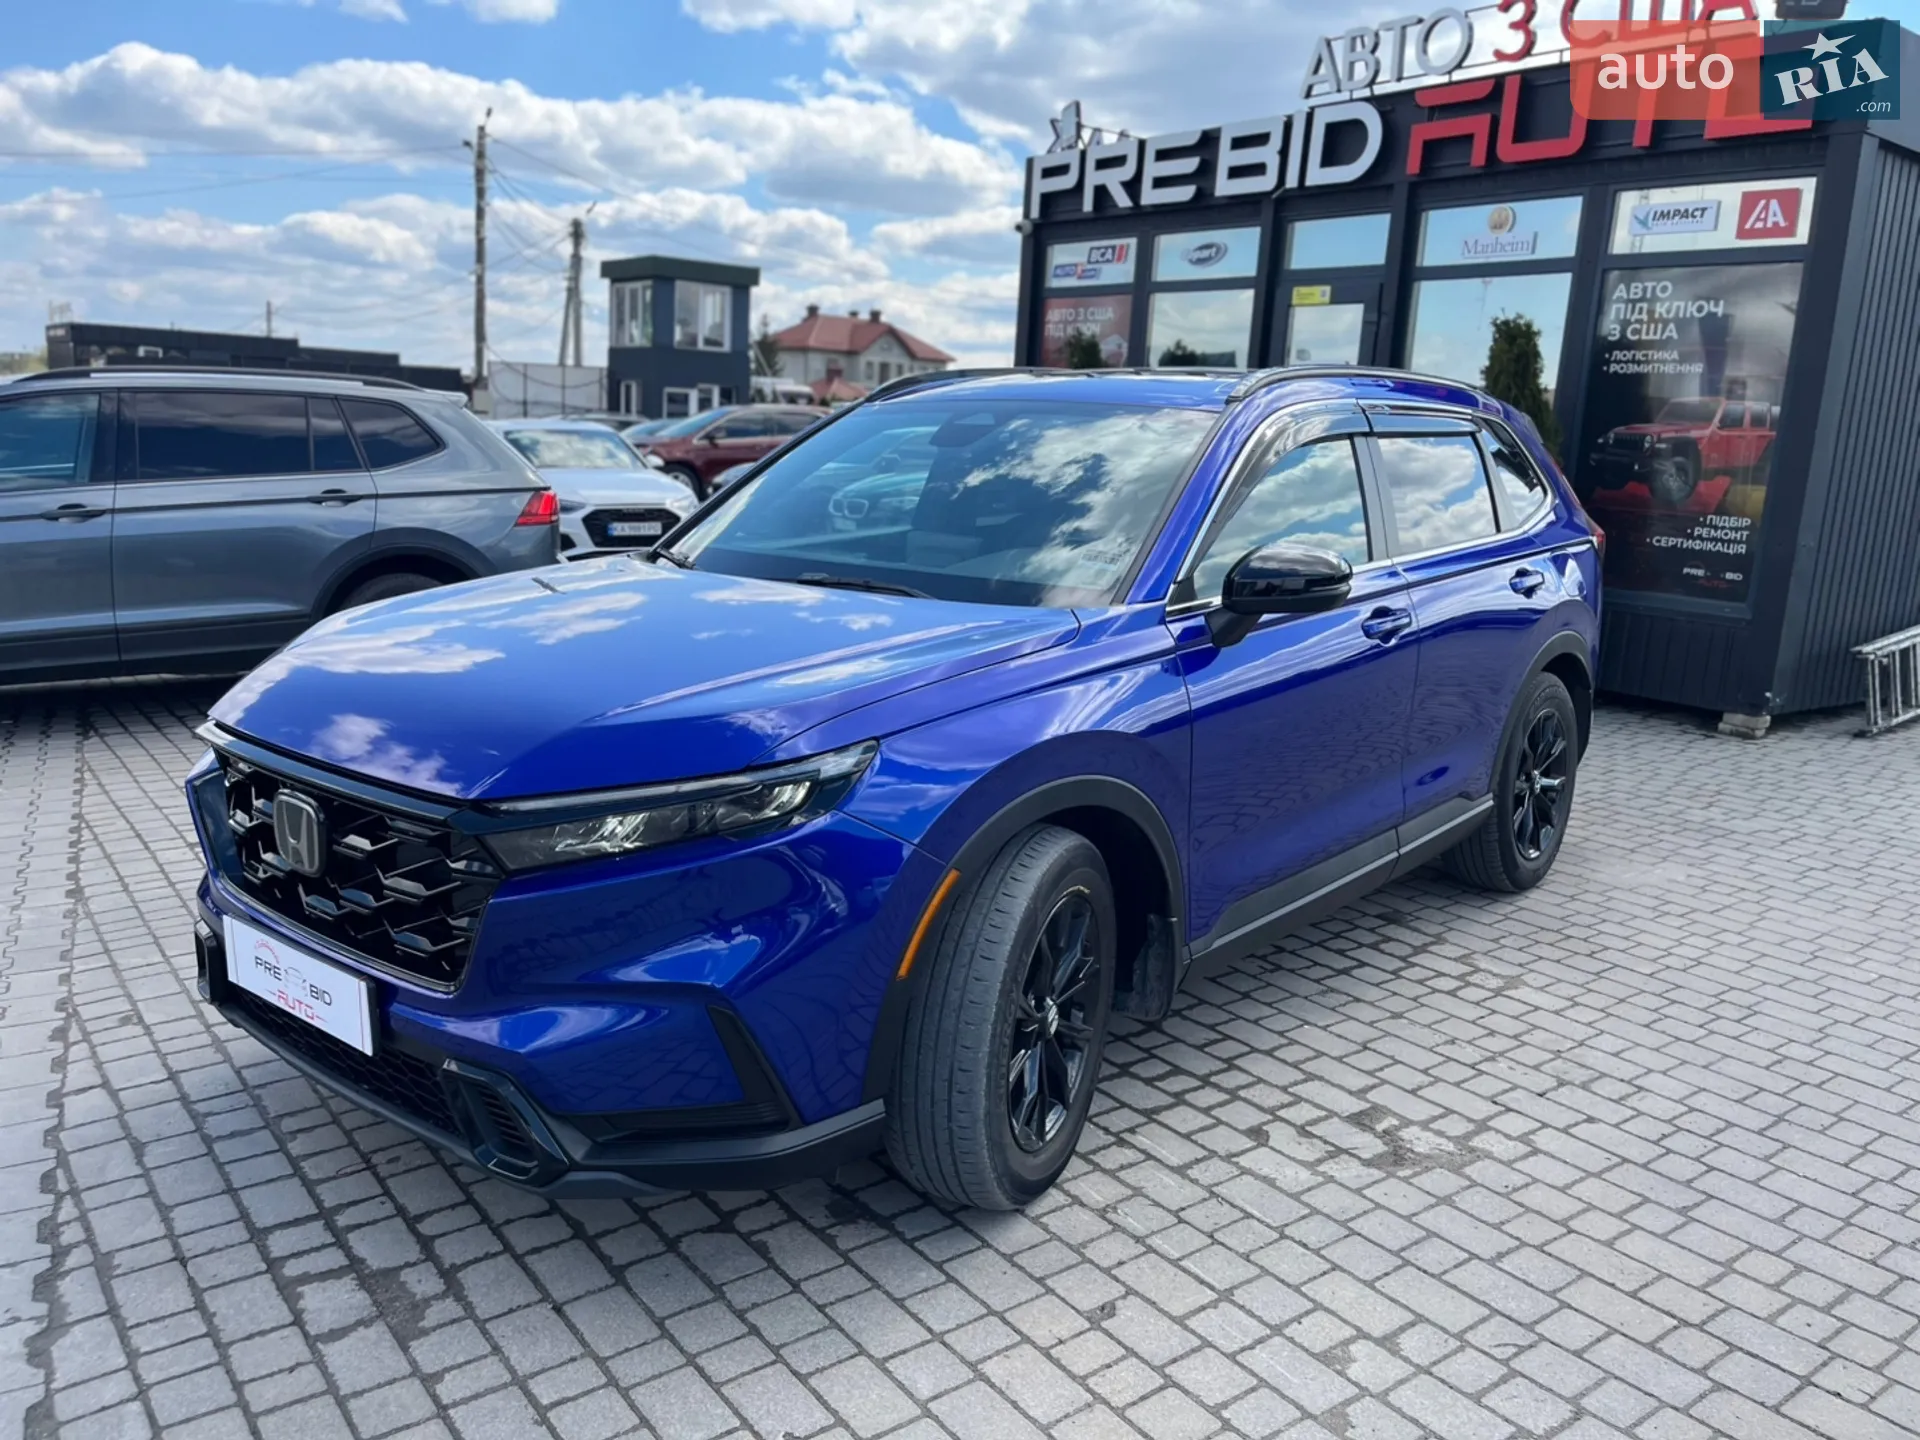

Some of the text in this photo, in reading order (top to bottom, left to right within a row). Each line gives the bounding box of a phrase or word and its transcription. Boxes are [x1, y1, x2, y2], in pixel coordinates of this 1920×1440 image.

[1303, 7, 1474, 98] АВТО
[1652, 206, 1708, 221] IMPACT
[1461, 236, 1531, 255] Manheim
[1090, 248, 1113, 263] BCA
[1612, 281, 1673, 300] АВТО
[1045, 308, 1075, 322] АВТО
[1610, 300, 1724, 322] ПІД КЛЮЧ
[1626, 322, 1678, 340] США
[1706, 515, 1751, 527] ПІДБІР
[1694, 527, 1749, 542] РЕМОНТ
[1652, 536, 1747, 555] СЕРТИФІКАЦІЯ
[254, 956, 333, 1007] PRE BID
